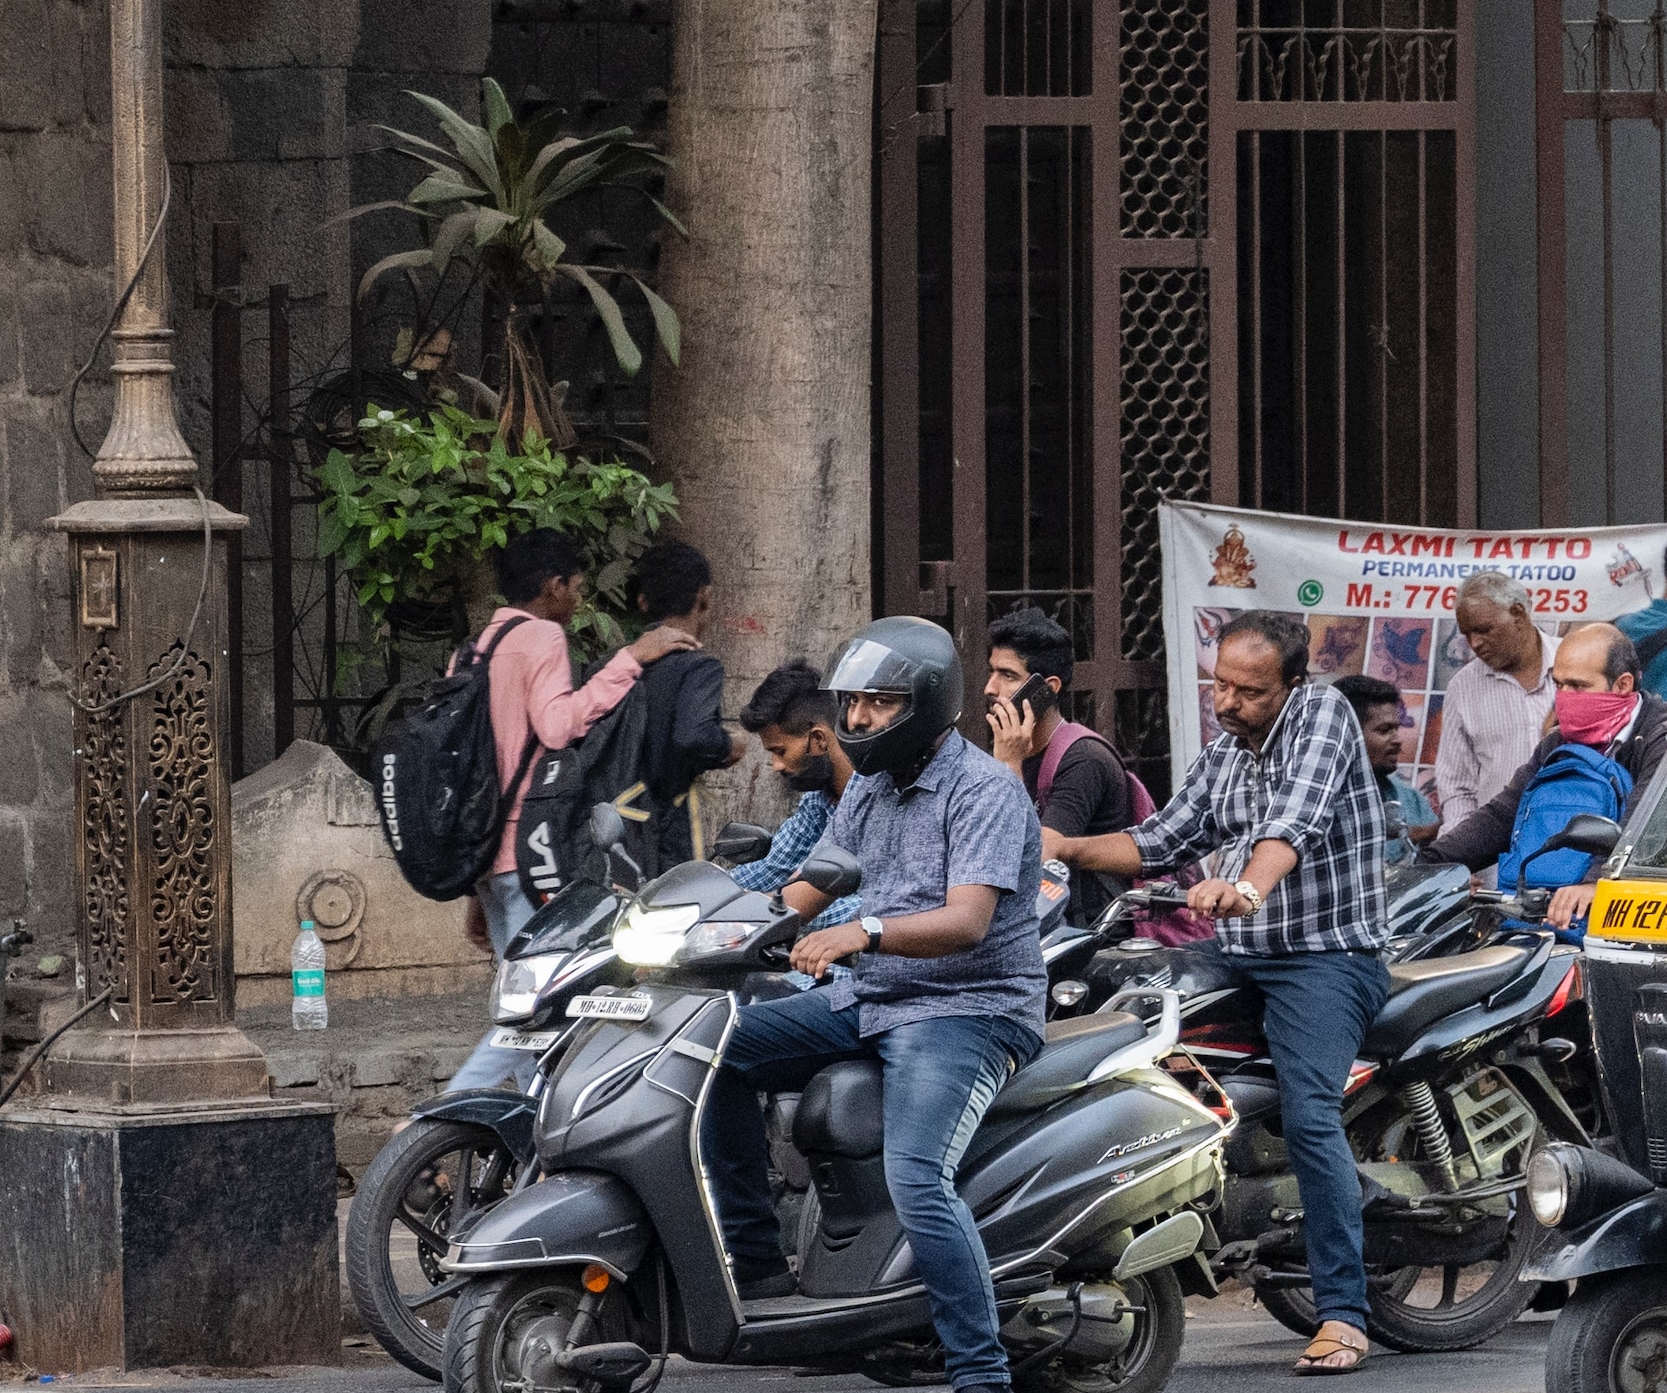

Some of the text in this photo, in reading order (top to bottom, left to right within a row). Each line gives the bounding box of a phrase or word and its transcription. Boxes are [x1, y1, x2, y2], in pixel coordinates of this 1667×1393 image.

[1338, 530, 1592, 560] LAXMI TATTO
[1506, 564, 1576, 581] TATOO
[1602, 899, 1634, 929] MH
